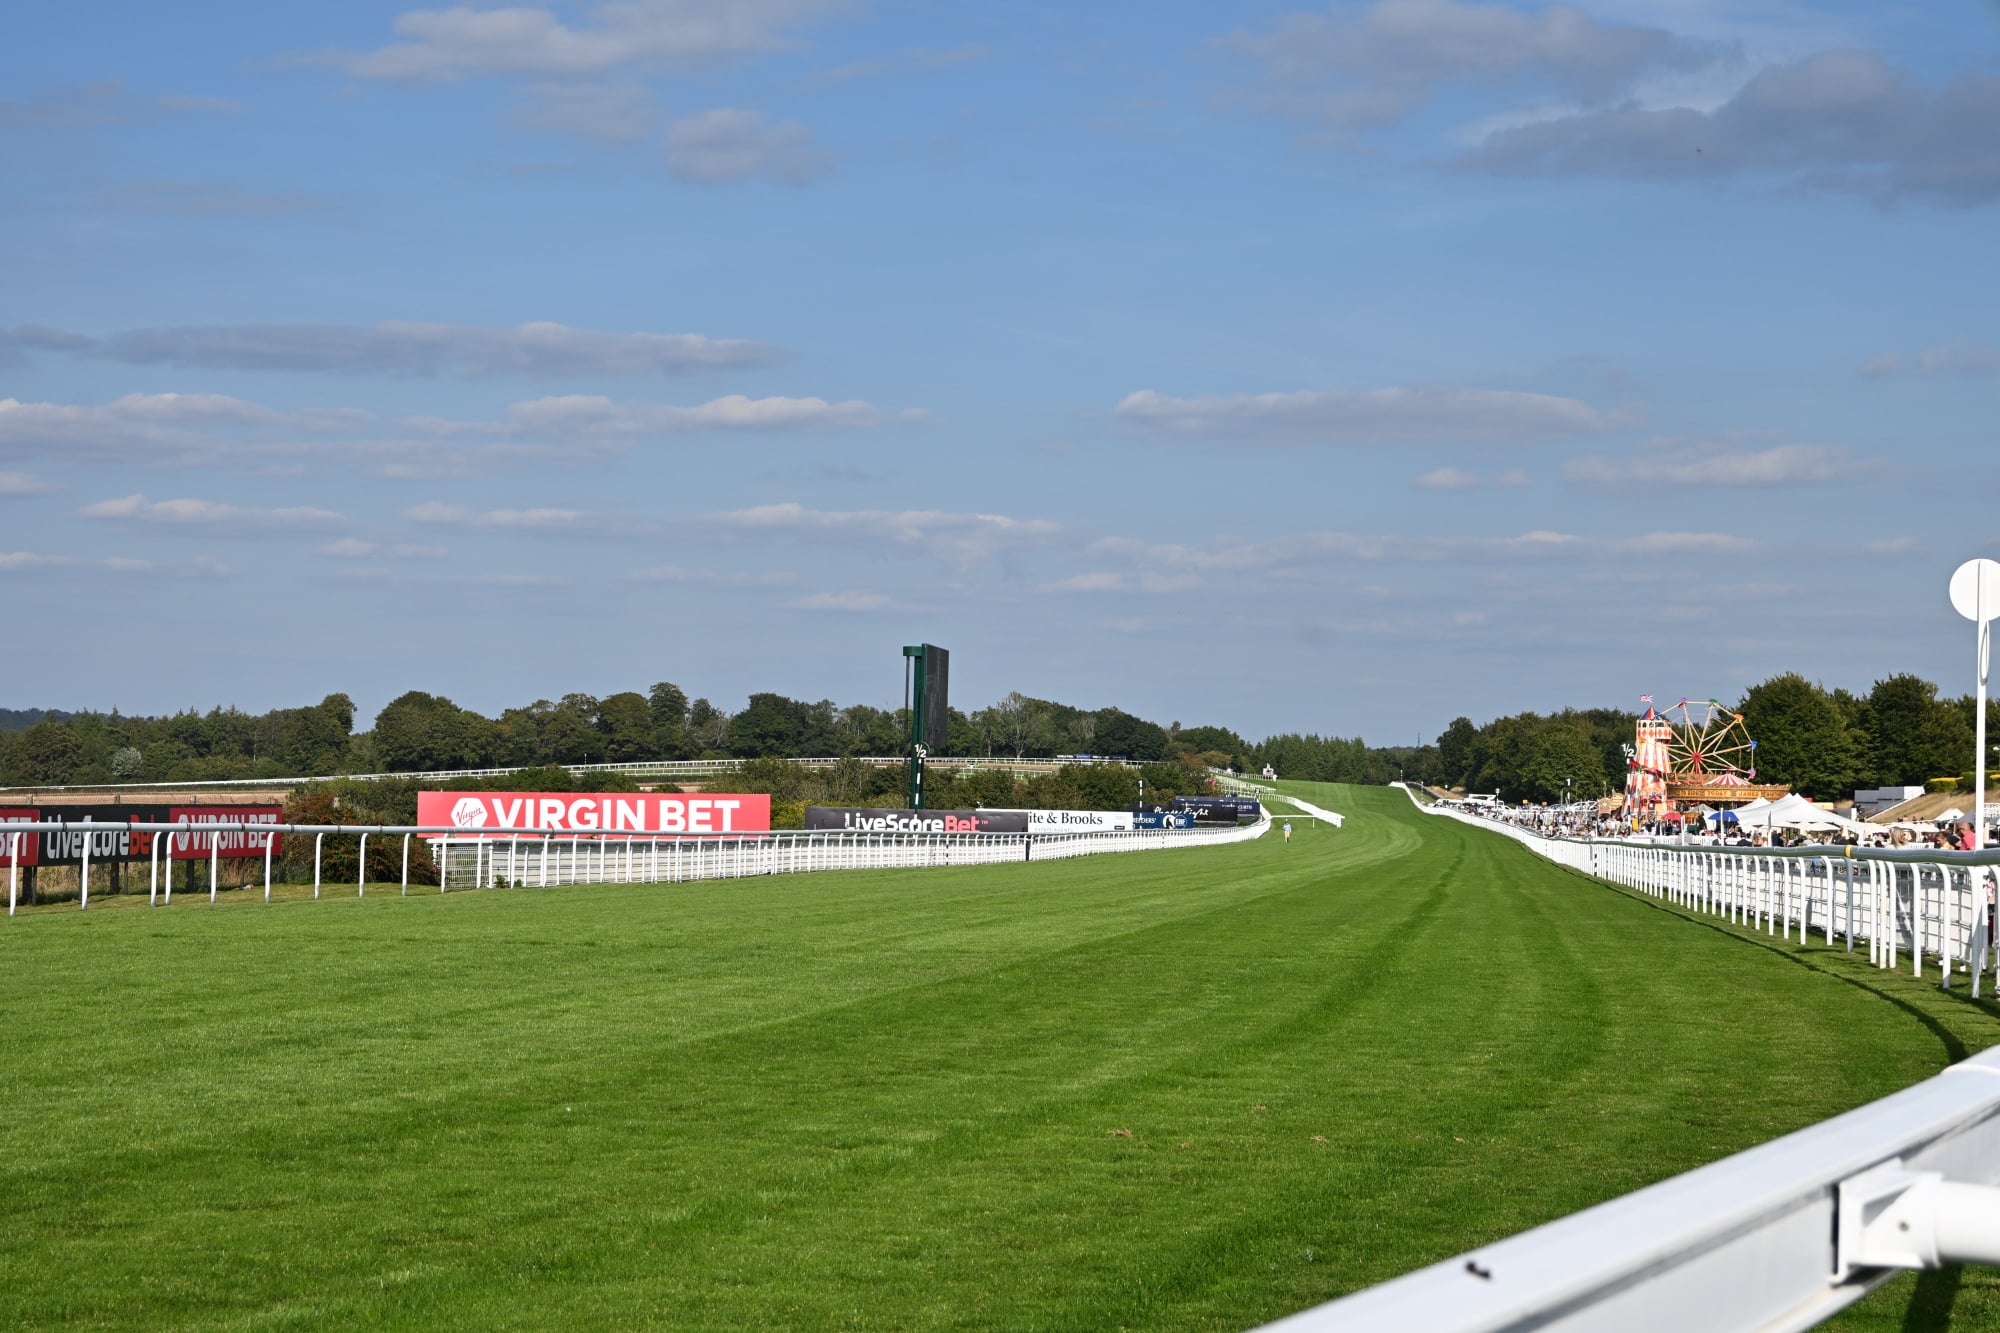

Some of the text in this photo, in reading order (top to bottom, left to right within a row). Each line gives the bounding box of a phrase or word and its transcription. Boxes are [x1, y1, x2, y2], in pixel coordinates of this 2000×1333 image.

[456, 802, 484, 827] Virgin
[491, 798, 740, 832] VIRGIN BET
[844, 812, 980, 832] LiveScoreBet
[1047, 812, 1057, 824] &
[1061, 812, 1103, 825] Brooks
[191, 814, 245, 850] VIRGIN
[248, 814, 277, 849] BET
